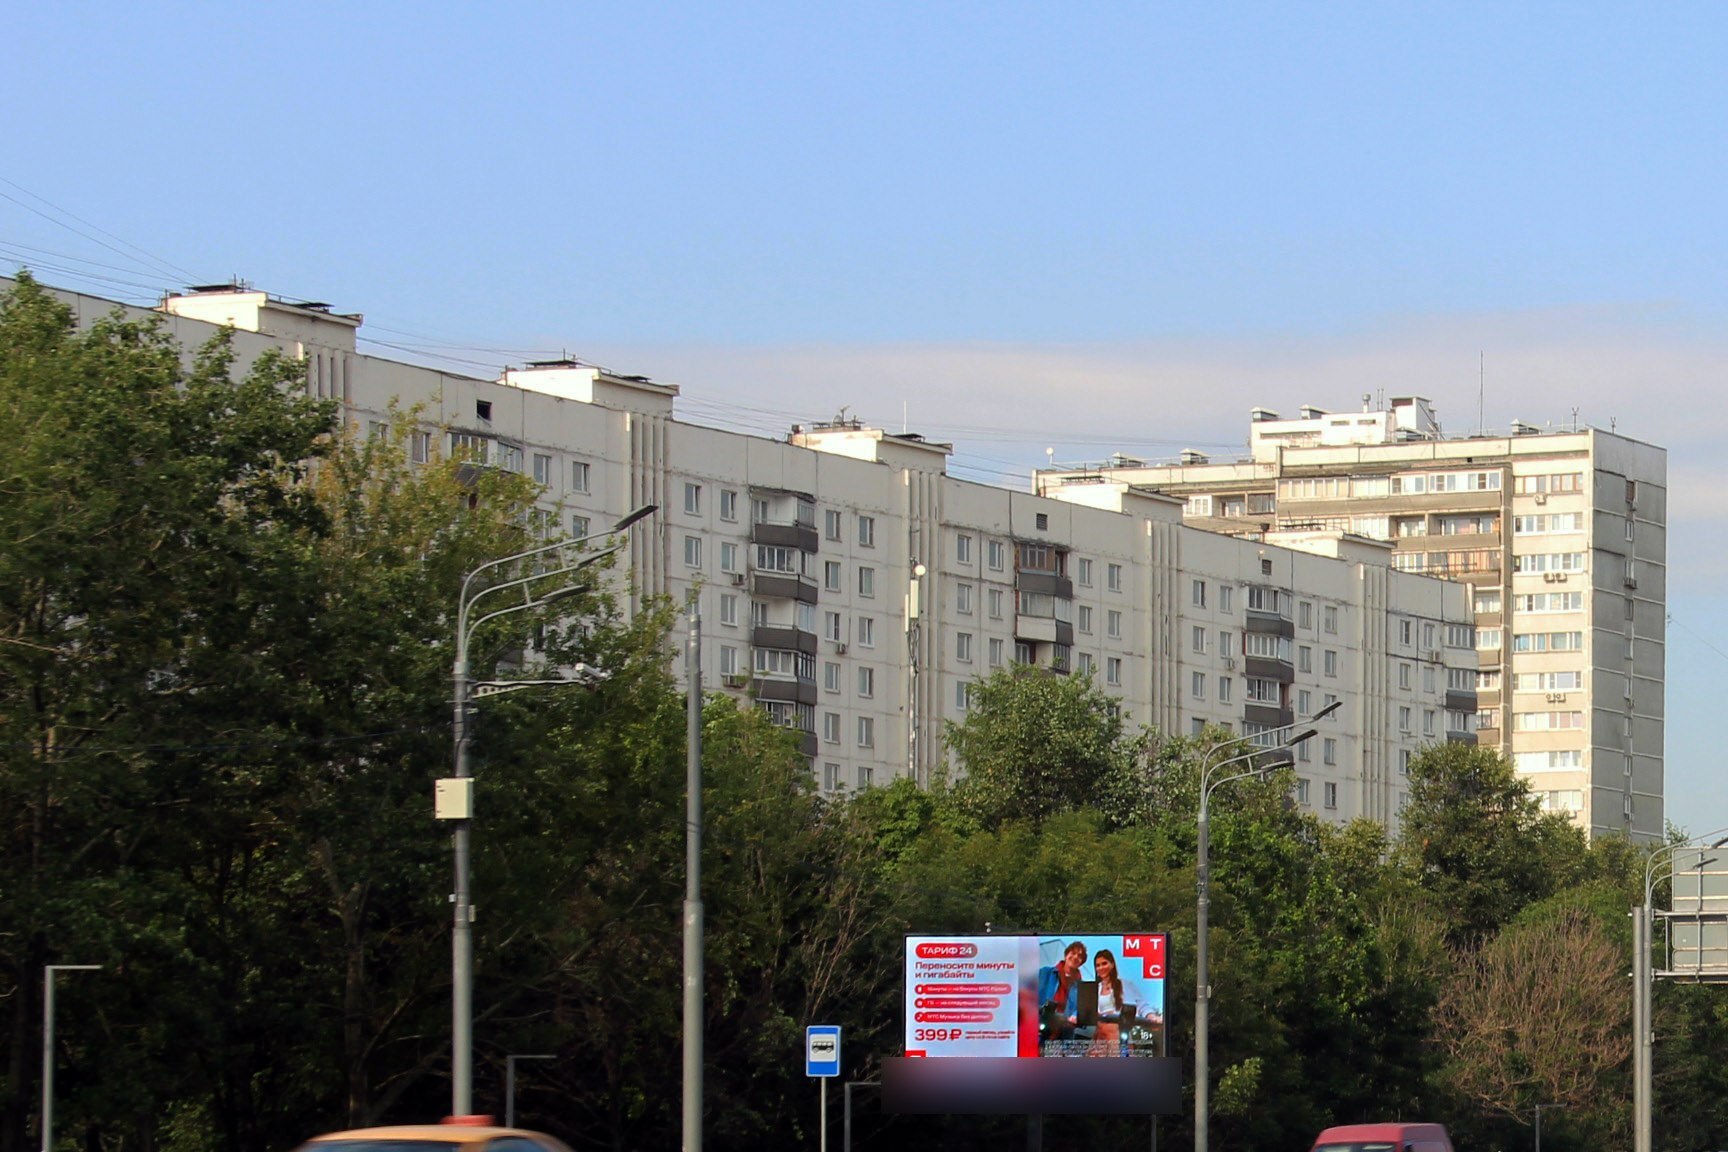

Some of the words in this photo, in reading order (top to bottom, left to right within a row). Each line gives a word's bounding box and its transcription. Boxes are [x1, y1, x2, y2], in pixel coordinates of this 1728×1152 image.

[921, 946, 958, 955] ТАРИФ
[959, 946, 973, 955] 24
[915, 962, 974, 972] Переносите
[976, 963, 1015, 971] минуты
[915, 1029, 947, 1041] 399
